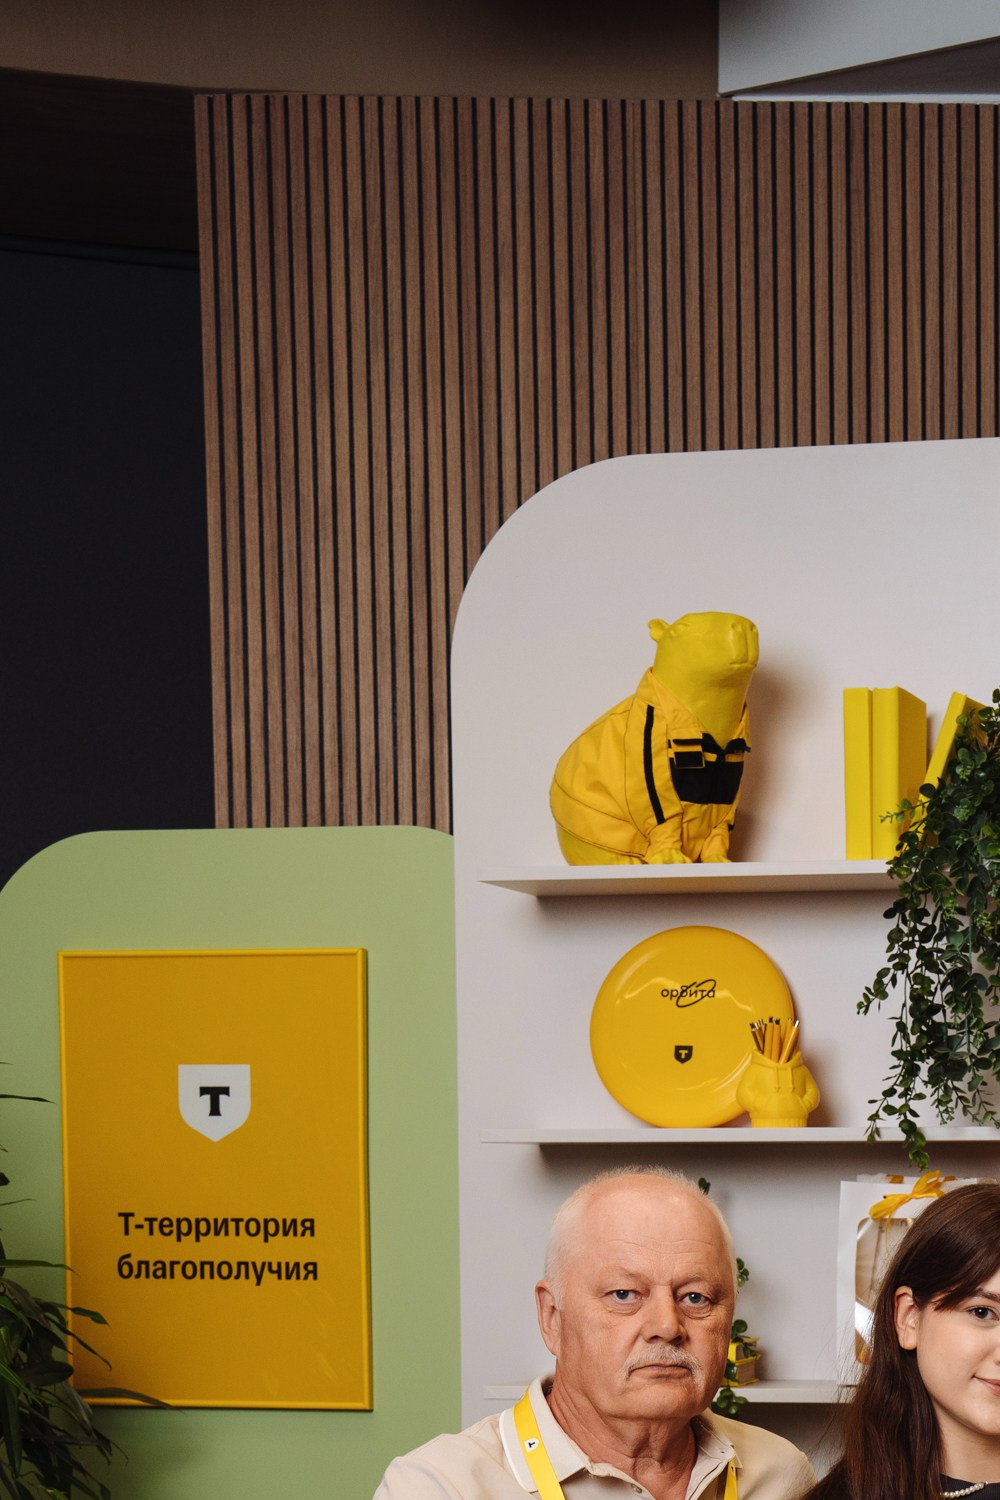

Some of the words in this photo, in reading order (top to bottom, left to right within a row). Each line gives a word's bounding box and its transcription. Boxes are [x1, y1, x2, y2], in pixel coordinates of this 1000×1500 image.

[199, 1086, 231, 1116] Т
[117, 1211, 316, 1243] Т-территория
[117, 1252, 319, 1286] благополучия
